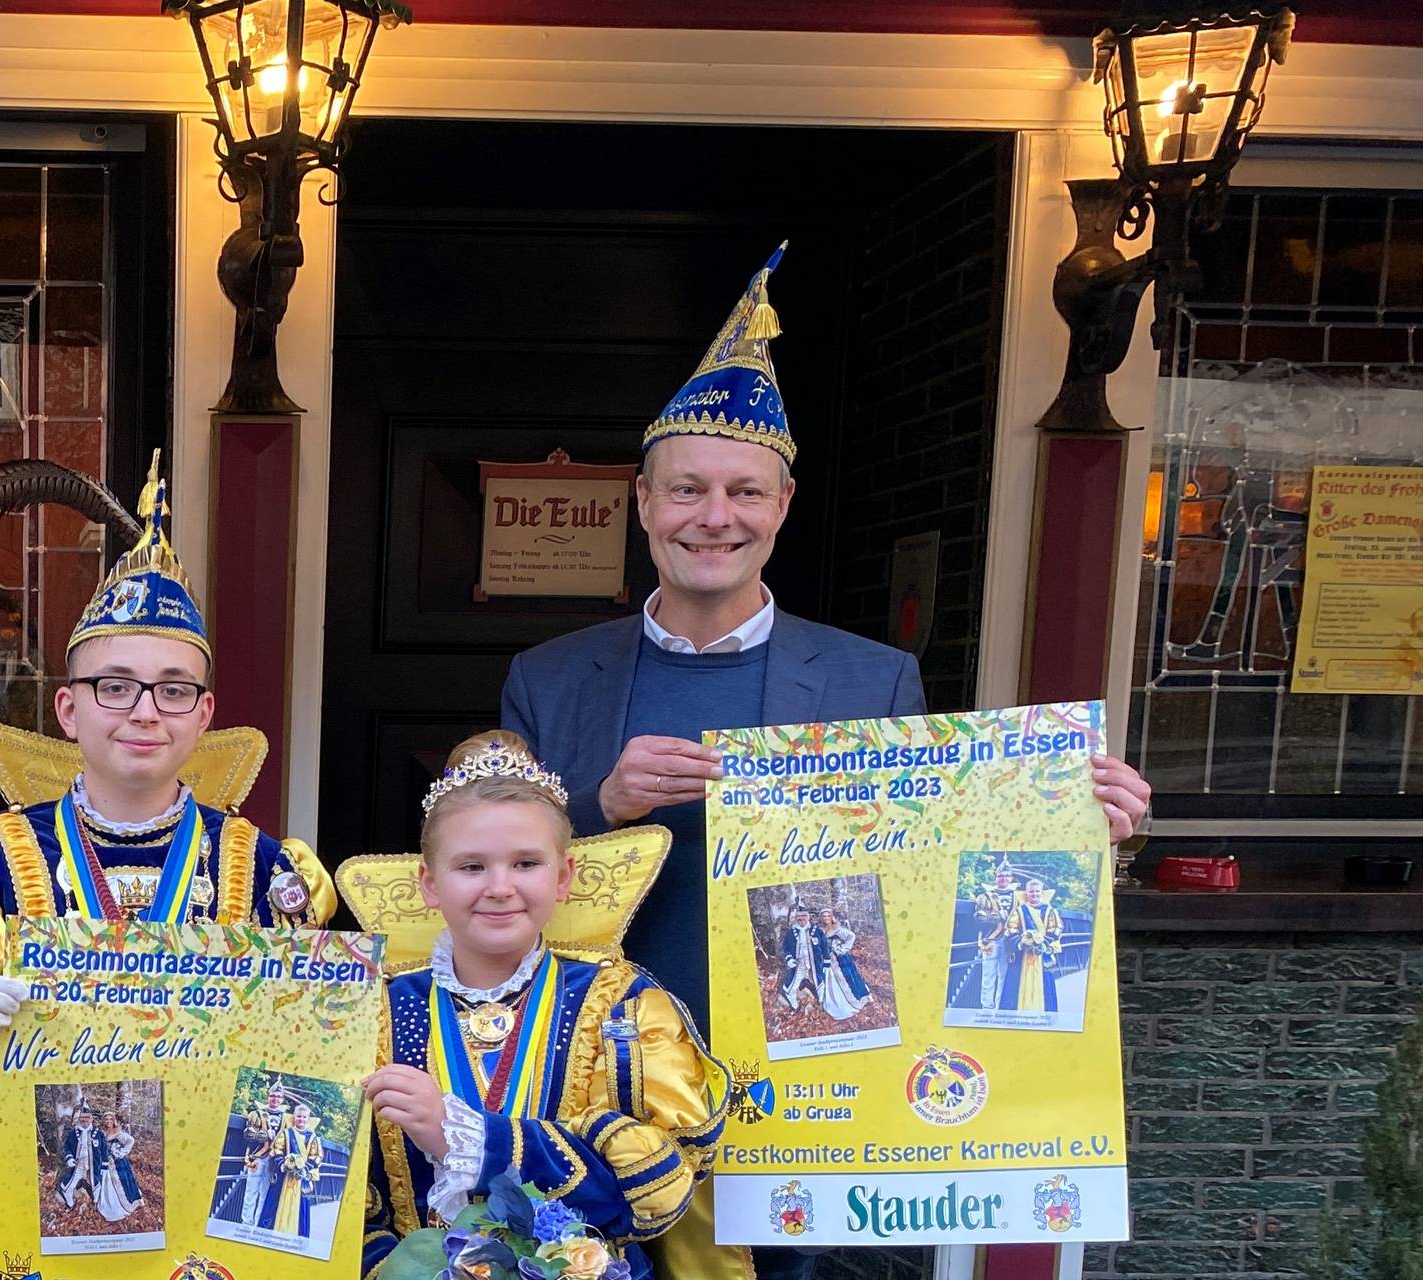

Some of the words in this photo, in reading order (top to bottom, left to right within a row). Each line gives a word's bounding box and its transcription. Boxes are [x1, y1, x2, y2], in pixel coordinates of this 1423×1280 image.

[1317, 481, 1358, 495] Ritter
[1360, 482, 1386, 496] des
[493, 495, 542, 528] Die
[1313, 514, 1358, 538] Große
[723, 742, 960, 777] Rosenmontagszug
[970, 738, 994, 762] in
[1004, 731, 1086, 758] Essen
[722, 787, 753, 806] am
[758, 787, 791, 805] 20.
[798, 783, 881, 804] Februar
[887, 777, 943, 800] 2023
[713, 832, 768, 879] Wir
[779, 825, 854, 866] laden
[23, 943, 254, 978] Rosenmontagszug
[261, 955, 283, 979] in
[291, 957, 365, 982] Essen
[30, 983, 49, 1000] m
[56, 981, 88, 1002] 20.
[95, 983, 174, 1006] Februar
[179, 987, 230, 1008] 2023
[3, 1028, 59, 1072] Wir
[70, 1026, 143, 1065] laden
[785, 1084, 824, 1099] 13:11
[831, 1083, 859, 1098] Uhr
[784, 1106, 801, 1119] ab
[806, 1106, 852, 1120] Gruga
[935, 1105, 979, 1125] Brauchtum
[724, 1143, 855, 1165] Festkomitee
[864, 1142, 953, 1163] Essener
[961, 1137, 1062, 1161] Karneval
[1070, 1136, 1114, 1158] e.V.
[846, 1181, 1002, 1238] Stauder
